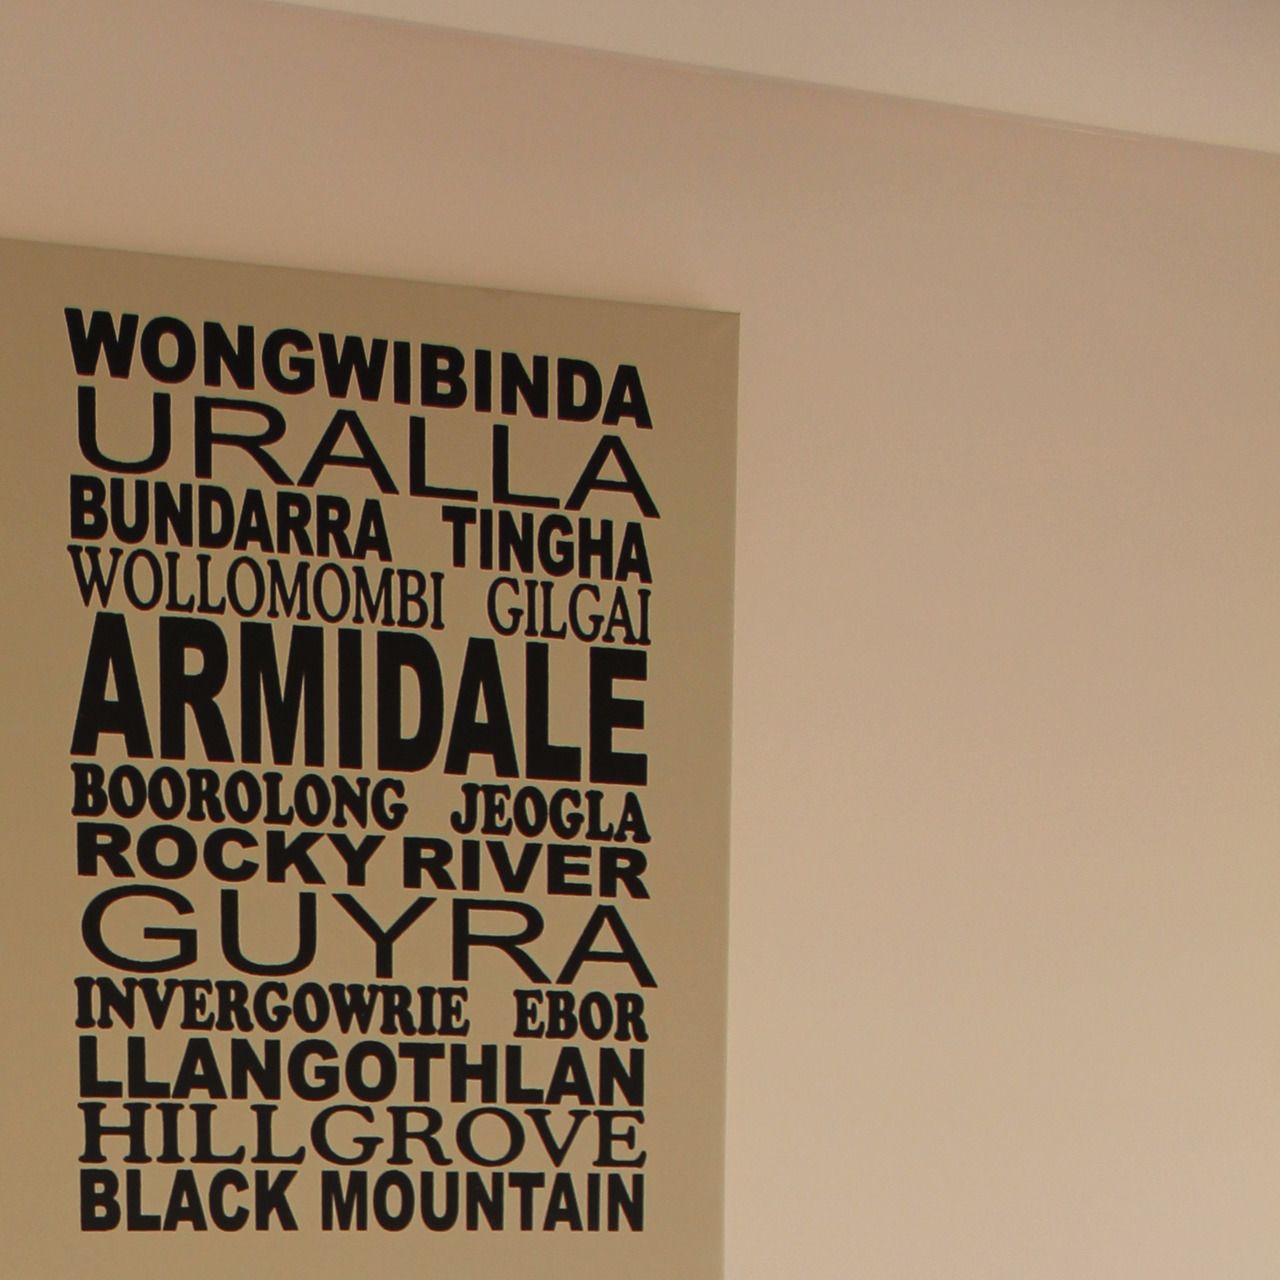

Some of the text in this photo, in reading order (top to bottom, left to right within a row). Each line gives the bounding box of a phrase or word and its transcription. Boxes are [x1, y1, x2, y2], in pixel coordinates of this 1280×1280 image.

[64, 307, 653, 429] WONGWIBINDA
[77, 384, 661, 520] URALLA
[69, 473, 653, 585] BUNDARRA TINGHA
[66, 543, 652, 647] WOLLOMOMBI GILGAI
[69, 610, 650, 787] ARMIDALE
[70, 761, 652, 845] BOOROLONG JEOGLA
[76, 821, 651, 900] ROCKY RIVER
[81, 883, 659, 989] GUYRA
[73, 975, 650, 1043] INVERGOWRIE EBOR
[78, 1034, 645, 1107] LLANGOTHLAN
[77, 1101, 648, 1169] HILLGROVE
[79, 1168, 645, 1232] BLACK MOUNTAIN
